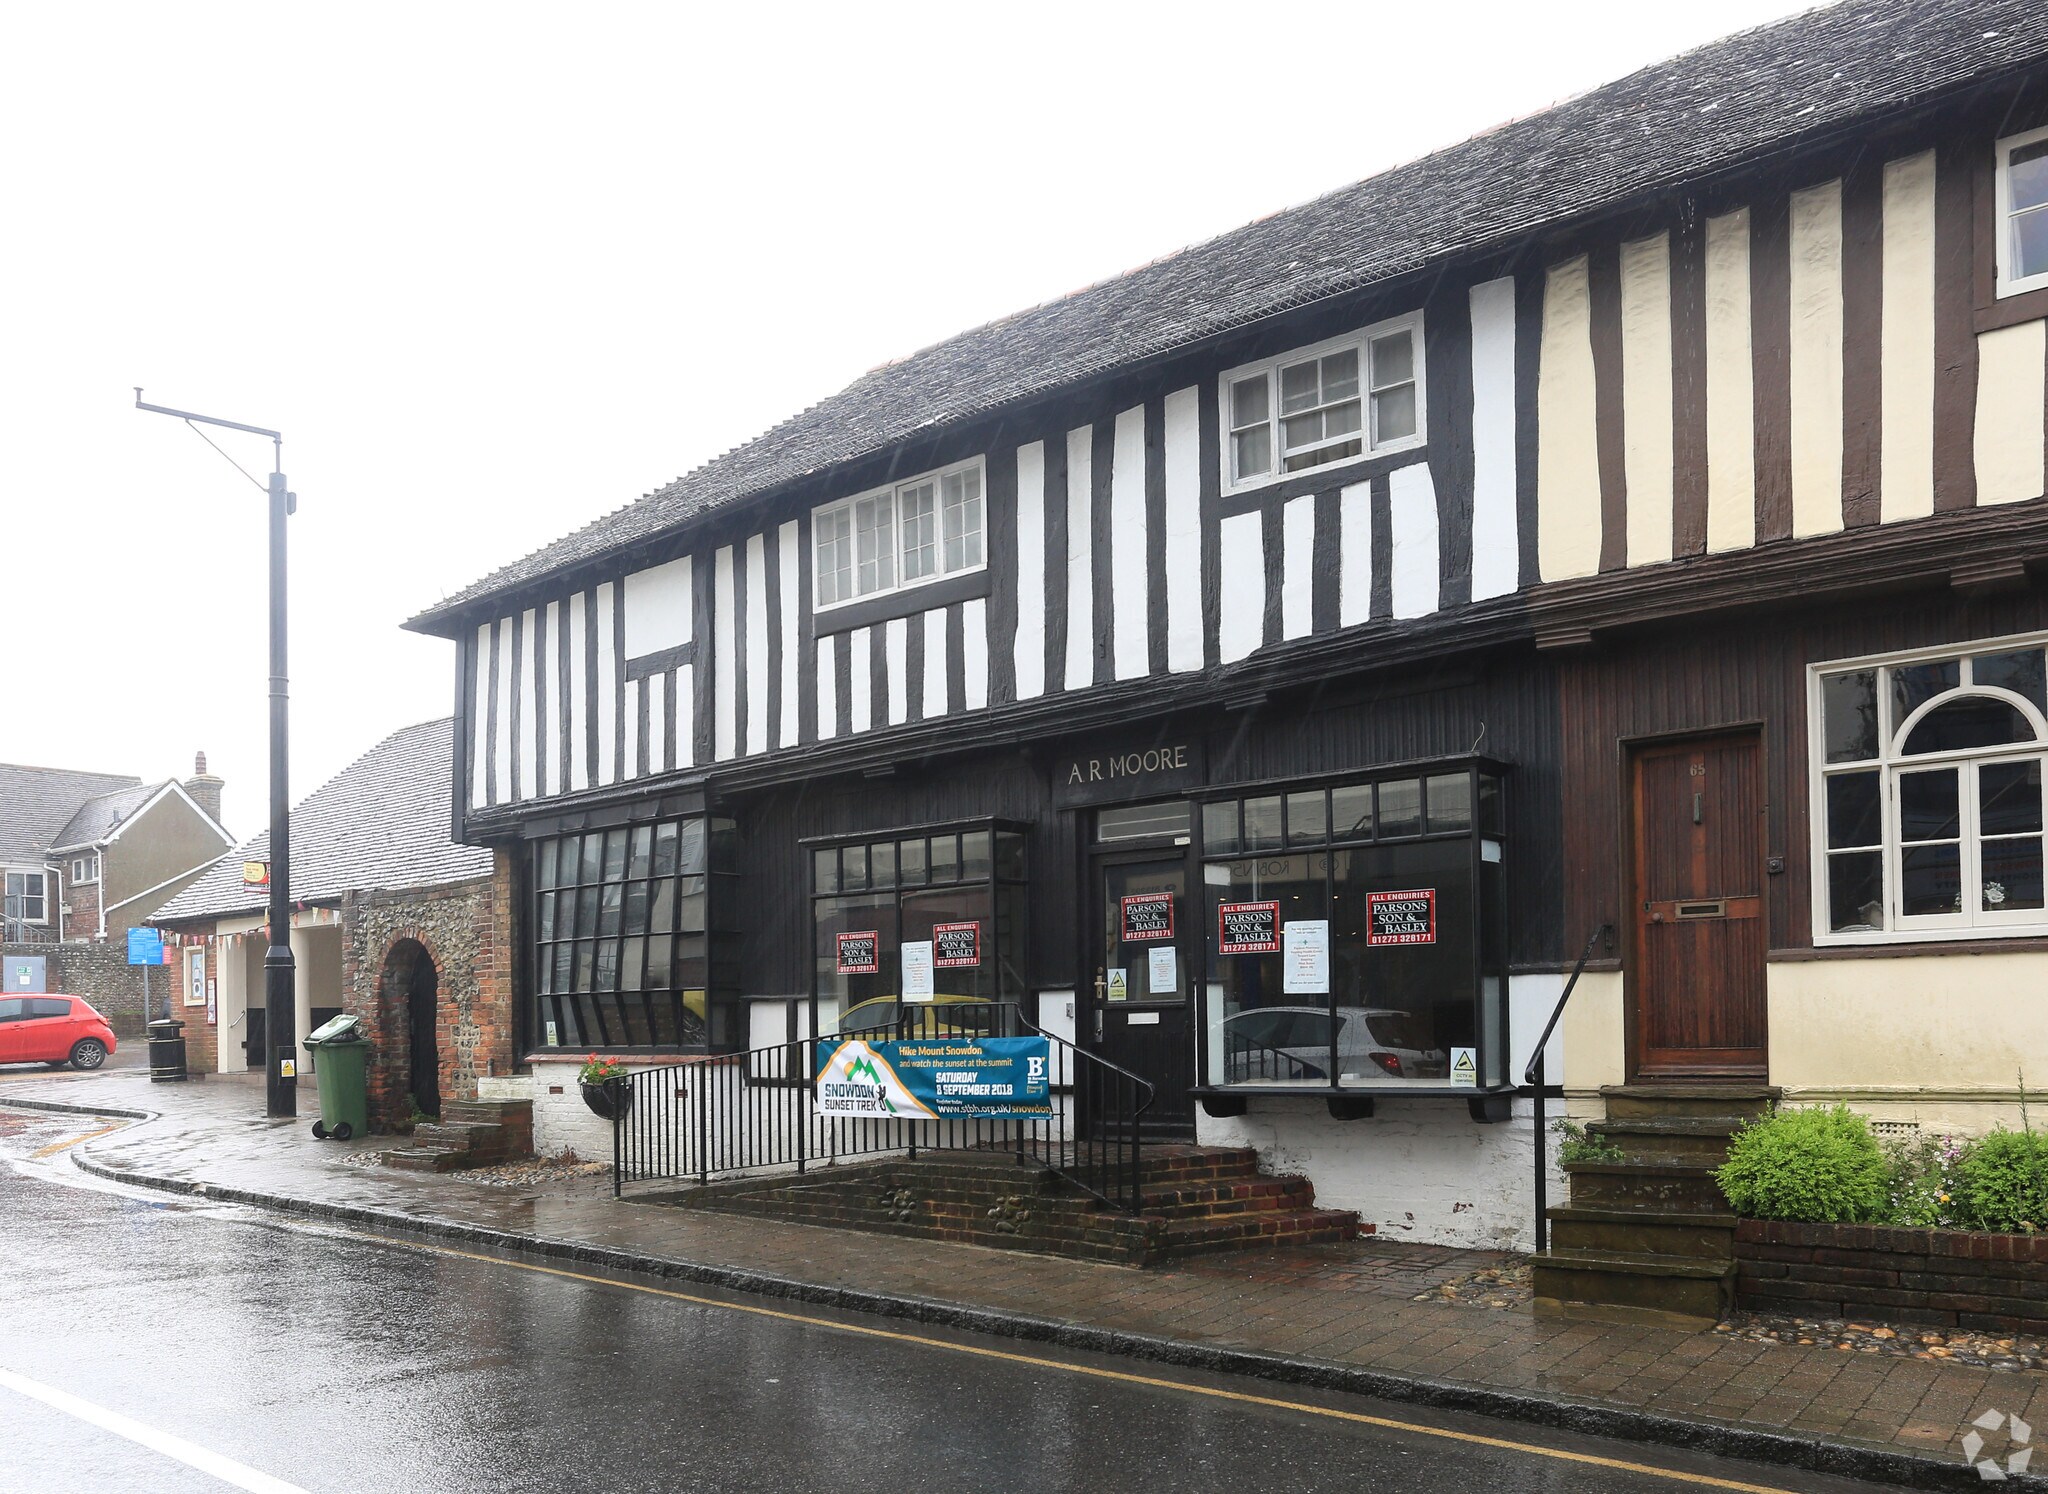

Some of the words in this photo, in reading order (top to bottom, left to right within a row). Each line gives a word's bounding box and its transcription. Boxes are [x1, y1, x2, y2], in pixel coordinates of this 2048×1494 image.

[1109, 745, 1188, 778] MOORE
[1690, 763, 1706, 777] 65
[1388, 891, 1430, 900] ENQUIRIES
[1126, 902, 1168, 914] PARSONS
[1237, 903, 1275, 911] ENQUIRIES
[1373, 902, 1427, 914] PARSONS
[1131, 912, 1150, 923] SON
[1151, 912, 1159, 920] &
[1225, 912, 1273, 924] PARSONS
[1379, 913, 1403, 924] SON
[1406, 913, 1416, 921] &
[1135, 920, 1168, 931] BASLEY
[1229, 923, 1252, 934] SON
[1253, 923, 1262, 931] &
[1385, 923, 1427, 934] BASLEY
[938, 931, 974, 942] PARSONS
[1235, 932, 1272, 943] BASLEY
[1372, 935, 1398, 944] 01273
[840, 940, 874, 951] PARSONS
[942, 941, 959, 951] SON
[959, 941, 967, 949] &
[1224, 944, 1247, 952] 01273
[843, 949, 859, 958] SON
[946, 949, 974, 959] BASLEY
[847, 956, 873, 966] BASLEY
[899, 1046, 917, 1056] Hike
[918, 1046, 945, 1056] Mount
[945, 1045, 983, 1056] Snowdon
[899, 1060, 911, 1068] and
[911, 1059, 931, 1068] watch
[932, 1059, 944, 1068] the
[944, 1059, 967, 1068] sunset
[967, 1059, 975, 1067] at
[975, 1058, 987, 1067] the
[988, 1057, 1013, 1067] summit
[935, 1071, 978, 1084] SATURDAY
[825, 1083, 875, 1099] SNOWDON
[936, 1084, 943, 1096] 8
[942, 1083, 990, 1096] SEPTEMBER
[991, 1083, 1013, 1096] 2018
[825, 1099, 855, 1111] SUNSET
[856, 1100, 877, 1112] TREK
[937, 1104, 1051, 1115] www.stbh.org.uk/snowdon
